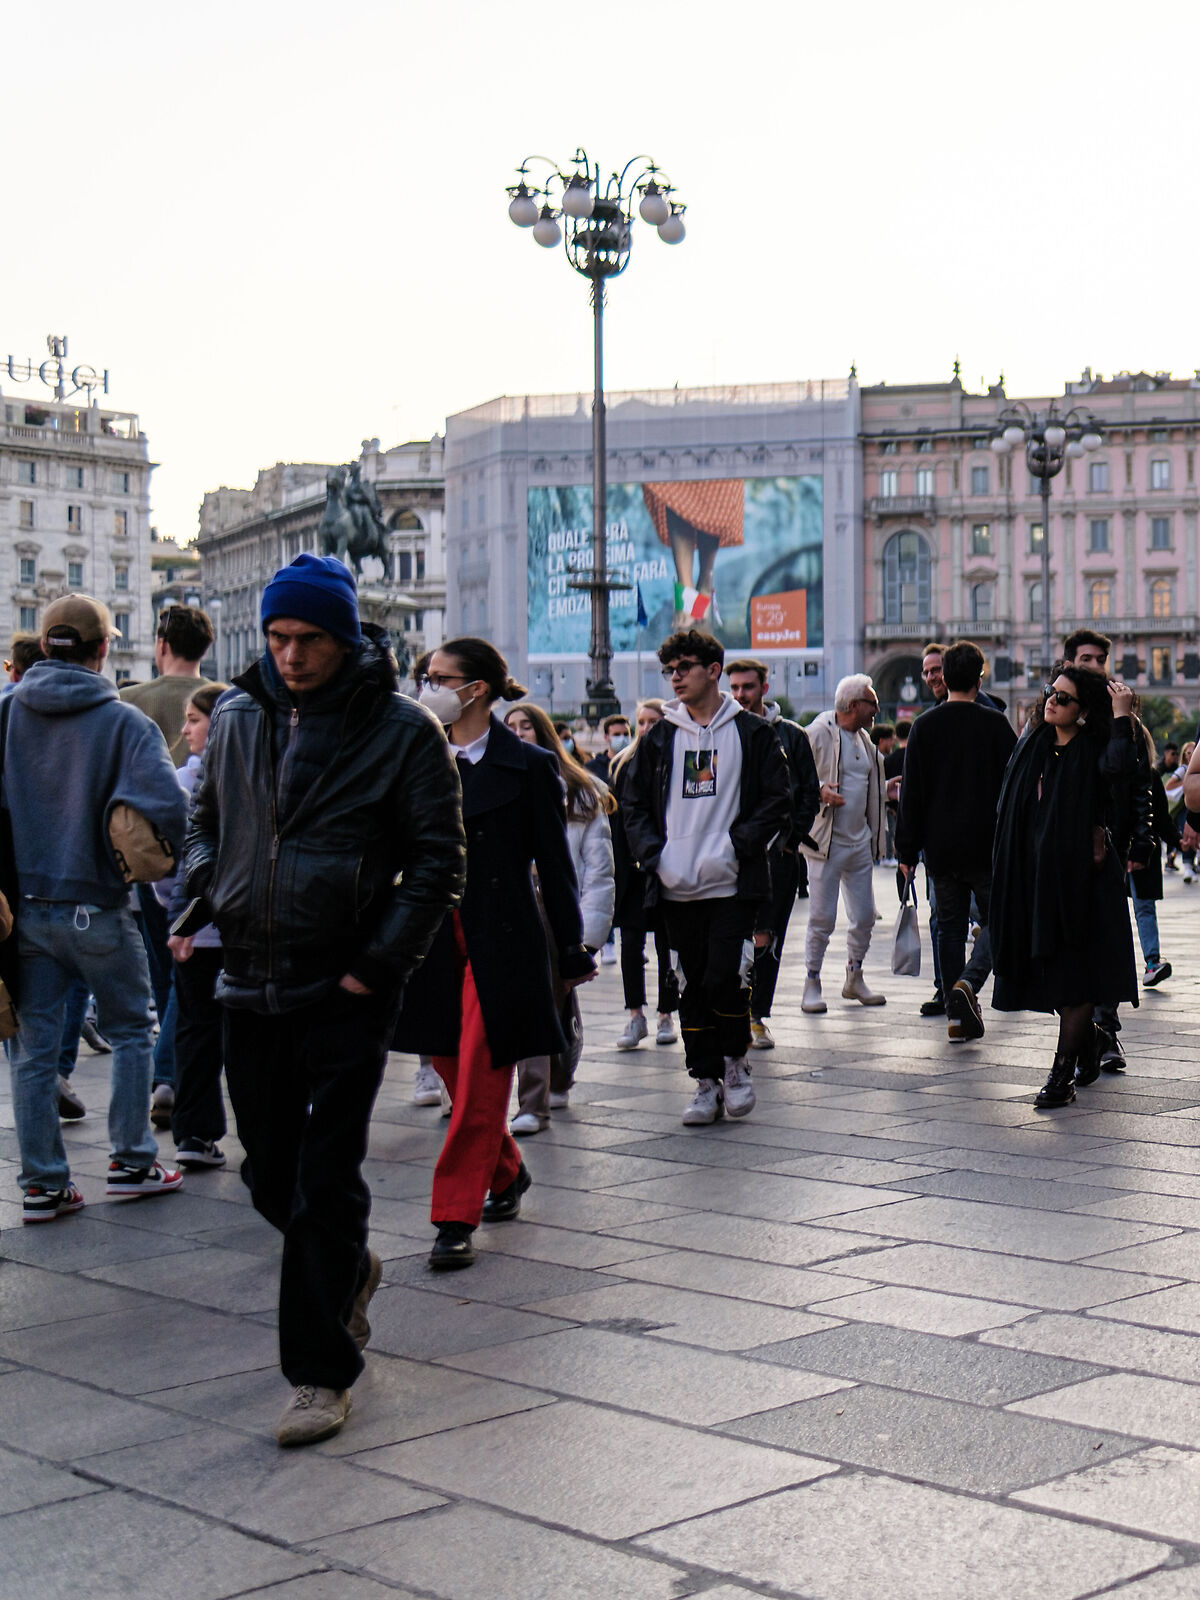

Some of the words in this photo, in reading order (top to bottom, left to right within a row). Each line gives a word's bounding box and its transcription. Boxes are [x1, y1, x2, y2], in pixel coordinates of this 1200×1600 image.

[548, 528, 590, 553] QUALE
[548, 554, 565, 575] LA
[568, 542, 635, 570] PROIMA
[633, 556, 668, 583] FARÀ
[757, 629, 801, 643] easyJet
